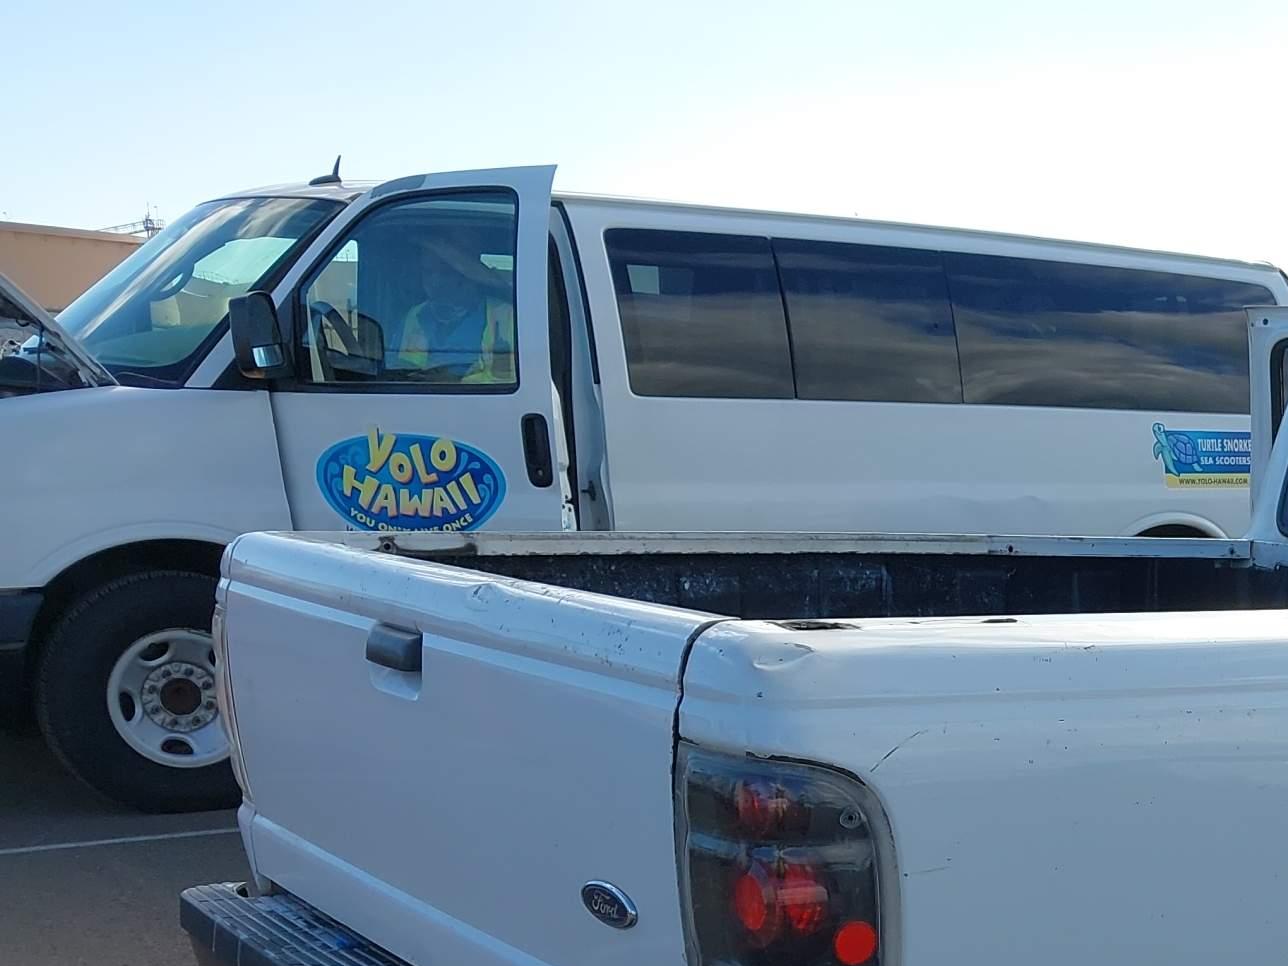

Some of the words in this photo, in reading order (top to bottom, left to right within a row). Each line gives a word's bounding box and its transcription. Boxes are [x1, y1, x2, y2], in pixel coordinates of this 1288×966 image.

[366, 424, 457, 484] YOLO
[1198, 439, 1222, 451] TURTLE
[1200, 456, 1214, 465] SEA
[1215, 456, 1251, 465] SCOOTERS
[342, 465, 482, 518] HAWAII
[350, 507, 375, 527] YOU
[443, 513, 473, 531] ONCE
[592, 890, 618, 918] Ford
